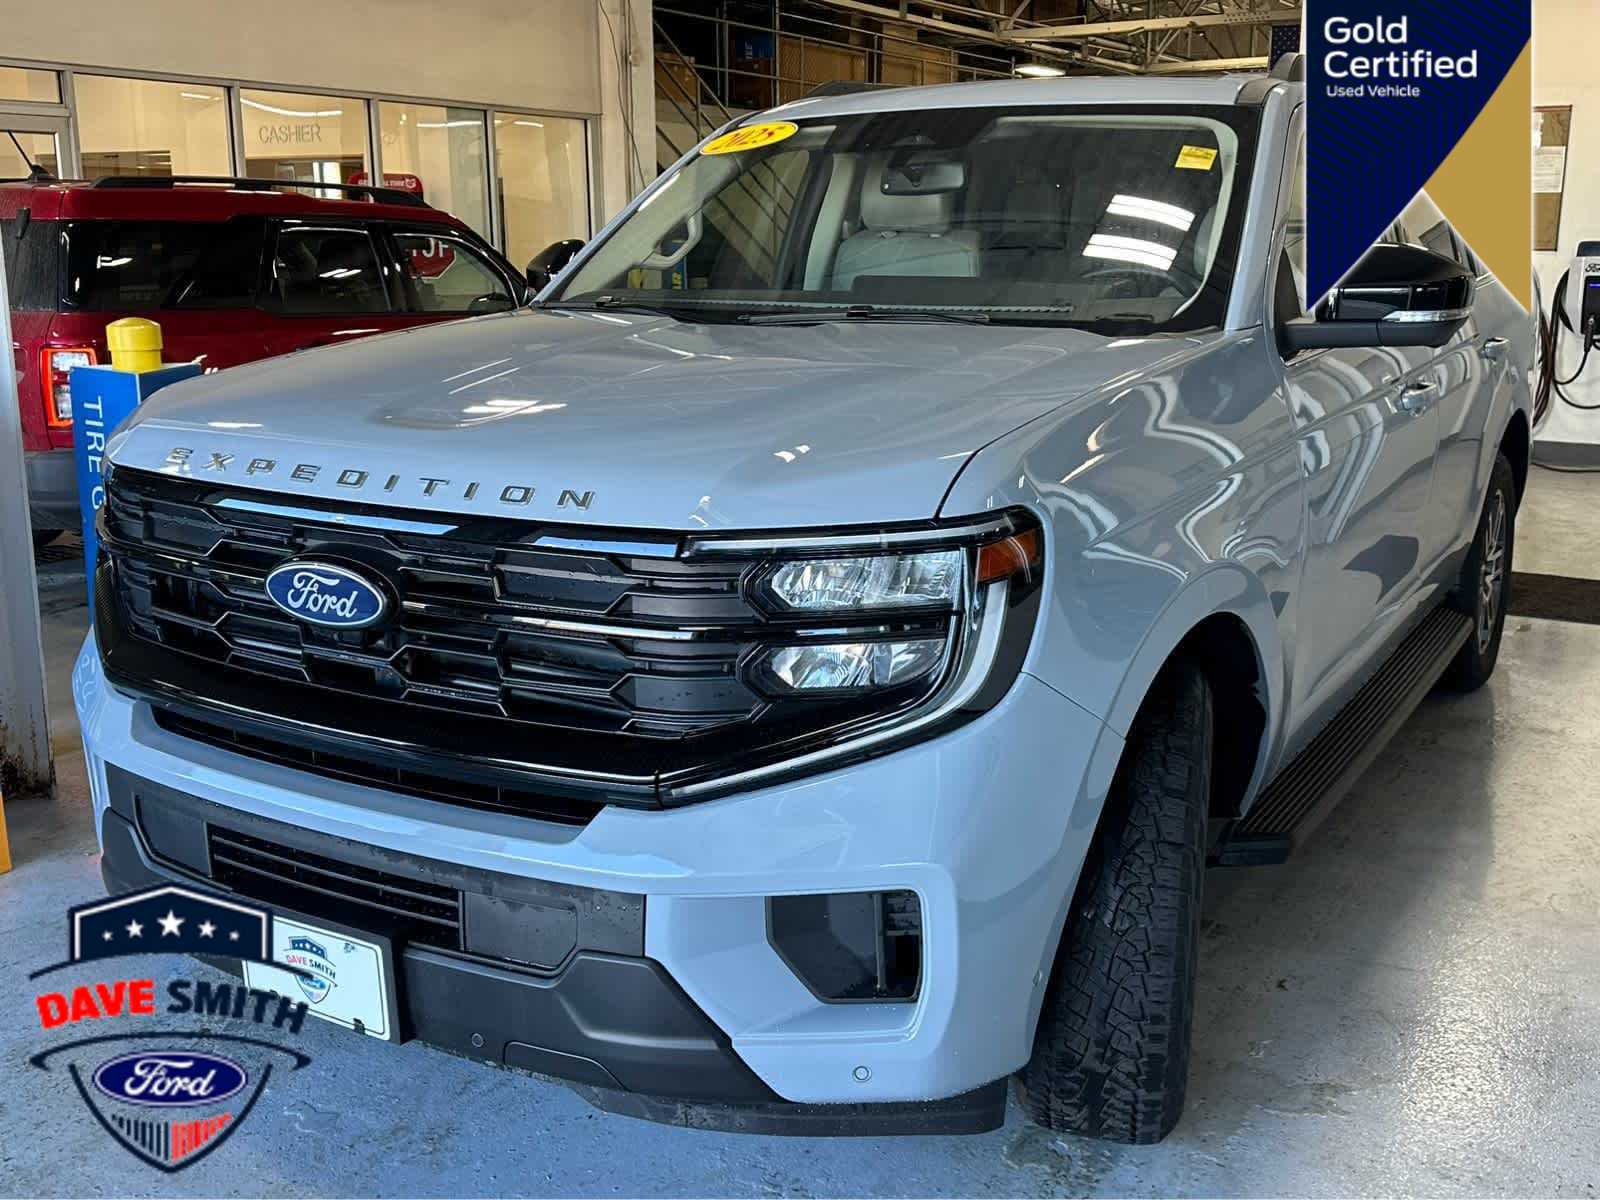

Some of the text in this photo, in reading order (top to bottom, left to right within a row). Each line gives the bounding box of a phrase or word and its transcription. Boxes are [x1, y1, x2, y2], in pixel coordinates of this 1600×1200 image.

[258, 123, 322, 143] CASHIER
[83, 395, 107, 510] TIRE G
[165, 447, 596, 511] EXPEDITION
[287, 571, 359, 619] Ford
[286, 954, 336, 979] DAVE SMITH
